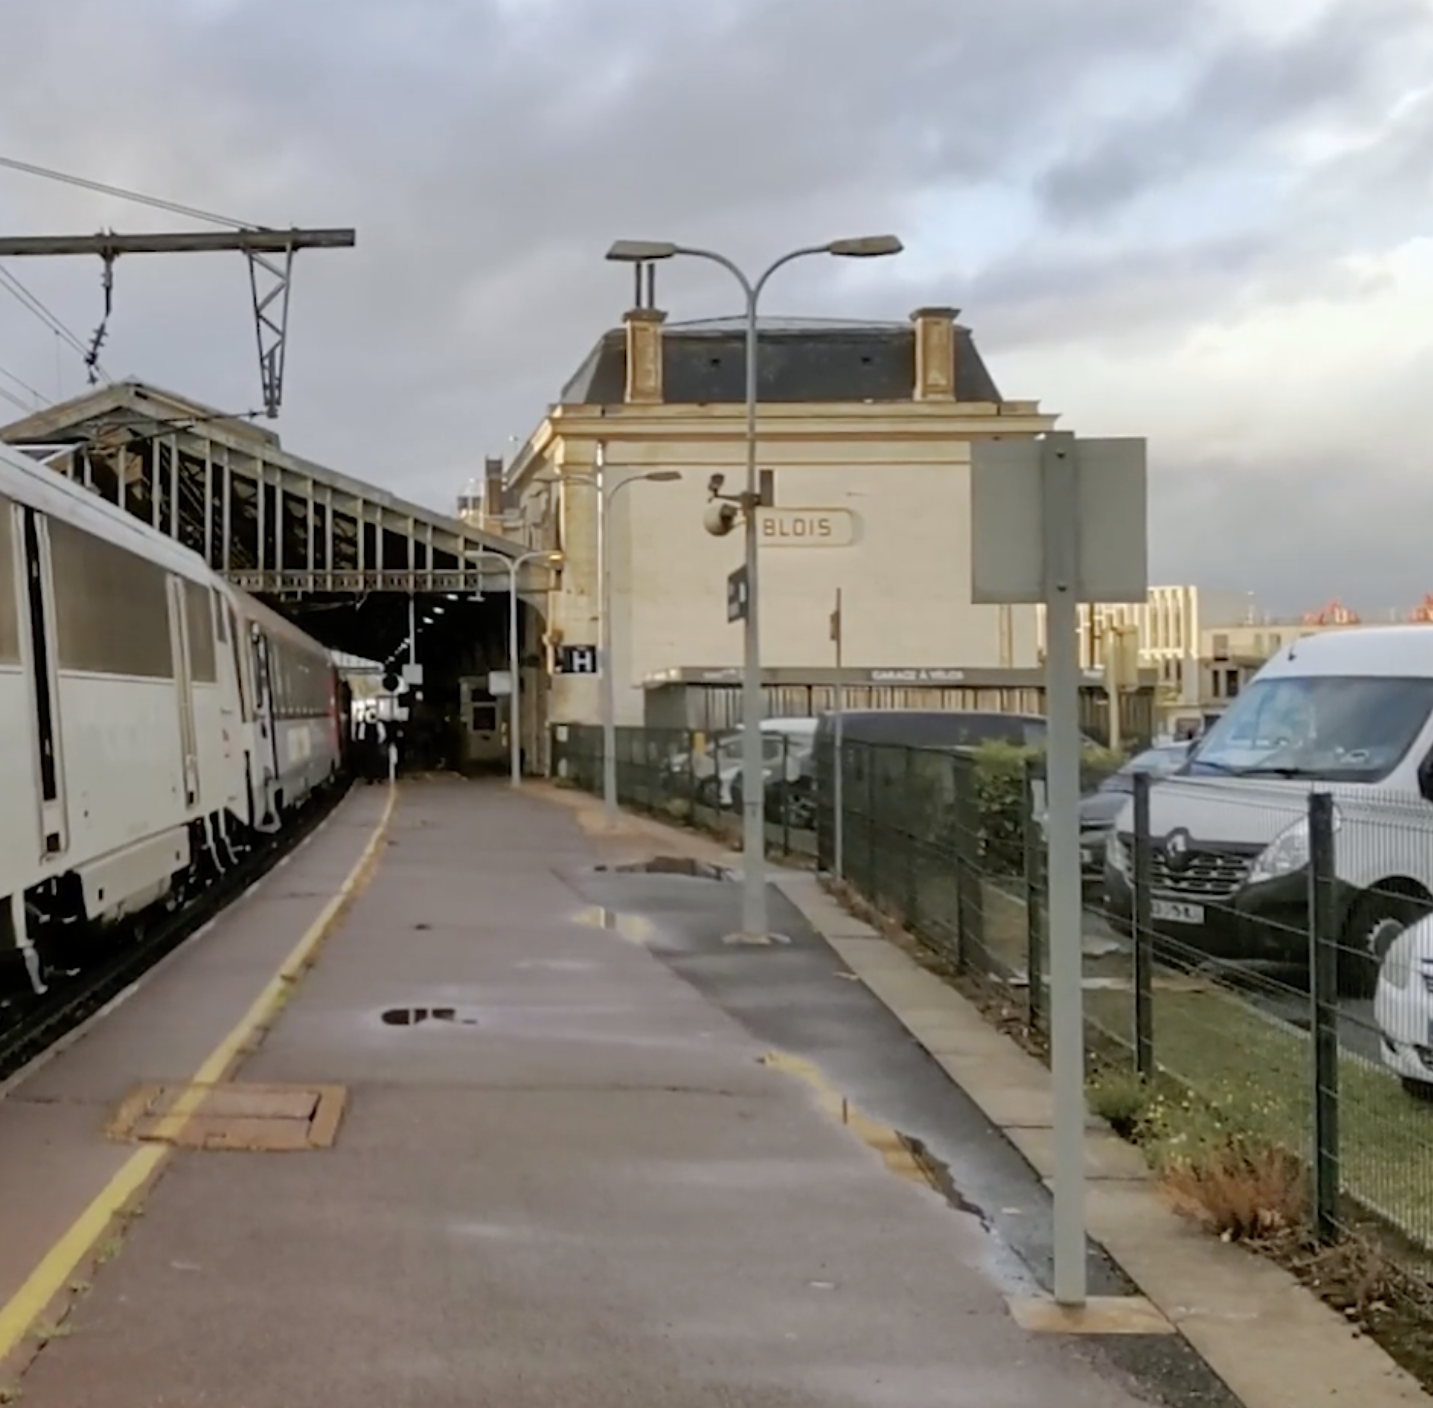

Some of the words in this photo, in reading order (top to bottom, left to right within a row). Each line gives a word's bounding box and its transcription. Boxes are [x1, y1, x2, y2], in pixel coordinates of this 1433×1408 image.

[763, 518, 832, 536] BLOIS
[572, 650, 592, 672] H
[871, 669, 917, 681] GARAGE
